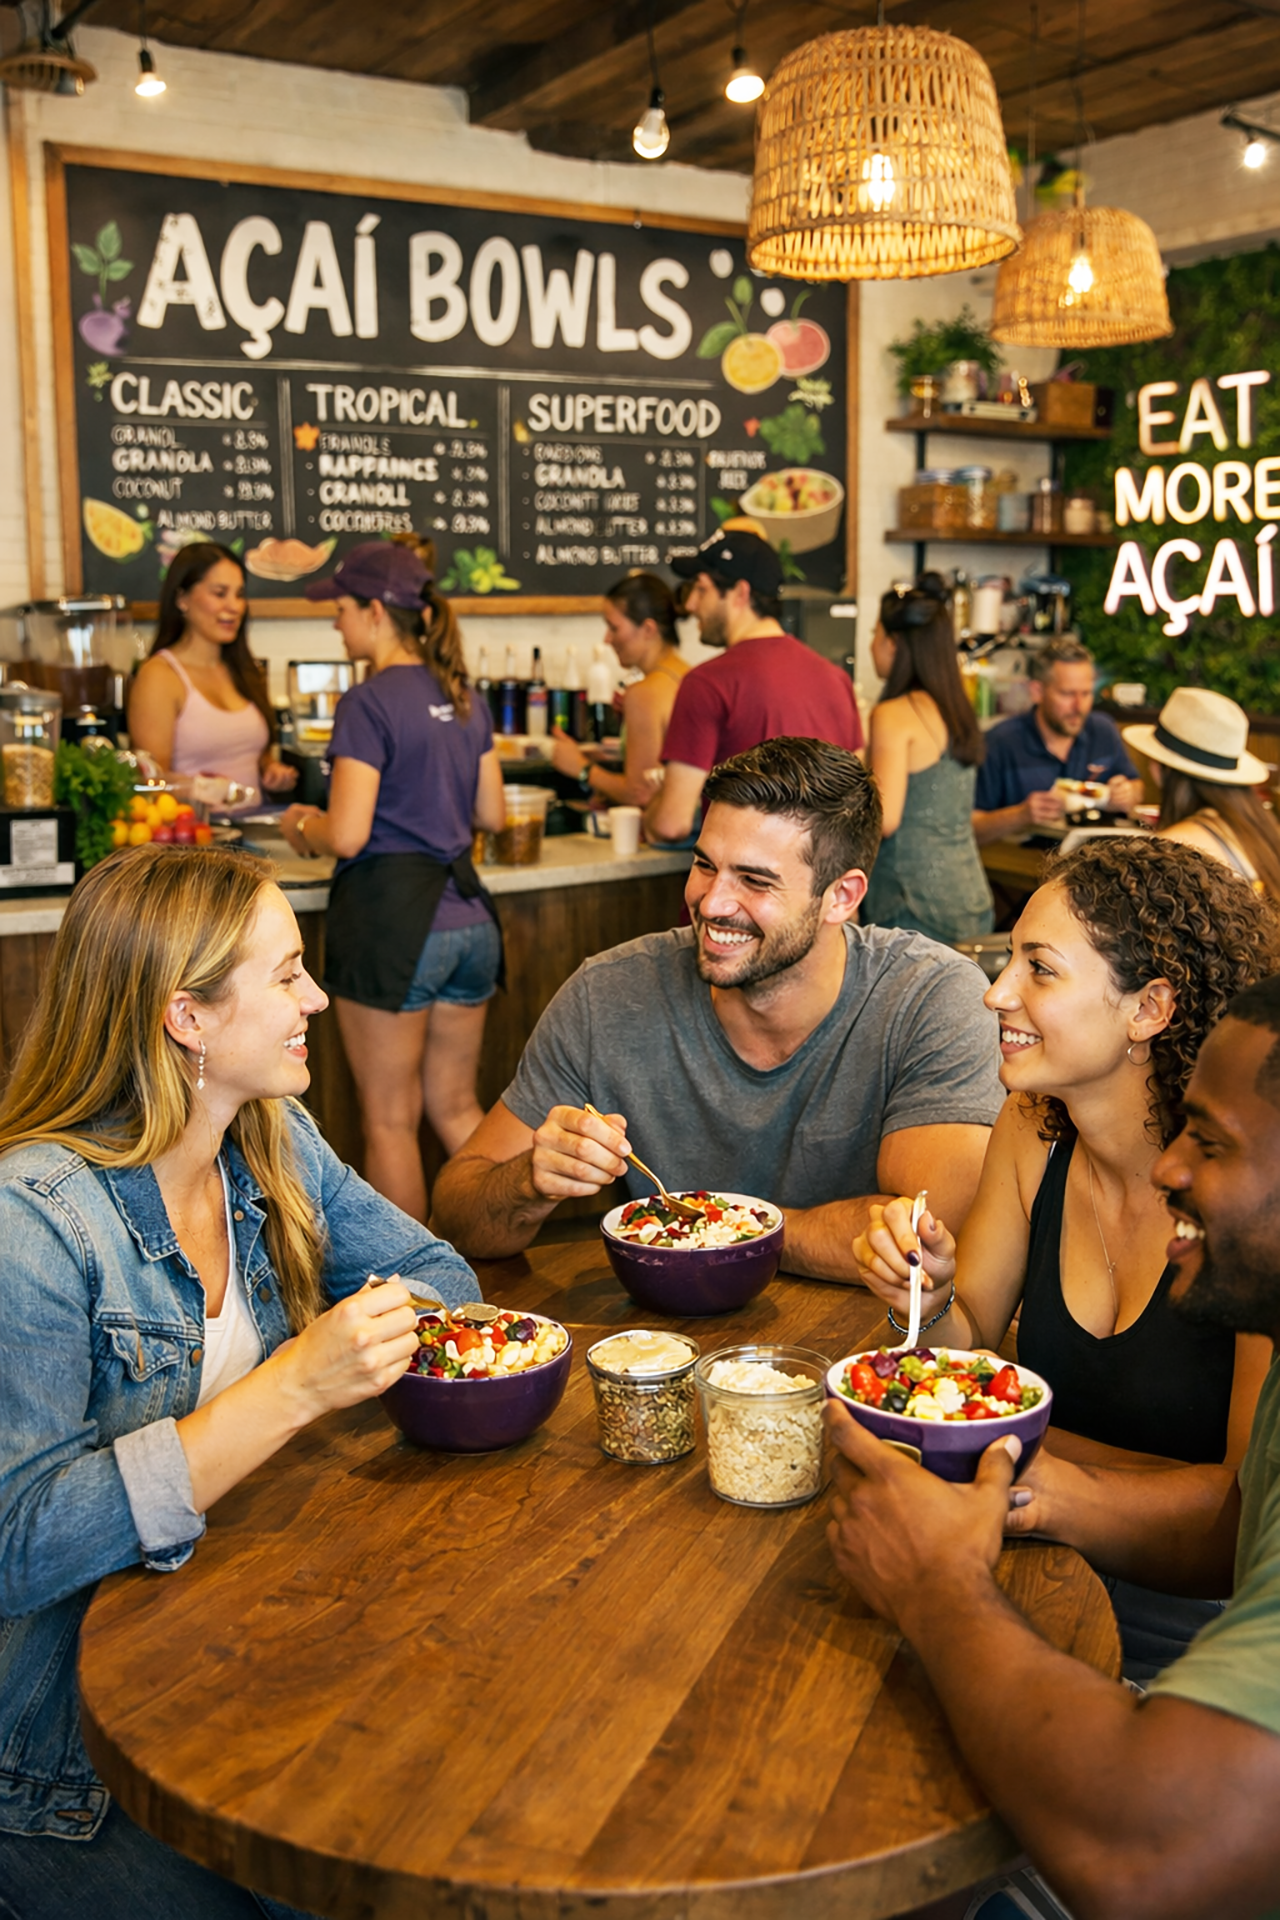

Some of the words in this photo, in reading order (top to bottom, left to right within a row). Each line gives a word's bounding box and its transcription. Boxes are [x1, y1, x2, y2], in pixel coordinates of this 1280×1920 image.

[136, 211, 381, 360] AÇAÍ
[409, 230, 693, 360] BOWLS
[110, 371, 255, 421] CLASSIC
[306, 382, 470, 429] TROPICAL
[527, 392, 722, 439] SUPERFOOD
[1137, 369, 1270, 457] EAT
[111, 446, 215, 473] GRANOLA
[1113, 455, 1280, 526] MORE
[1102, 522, 1279, 637] AÇAÍ
